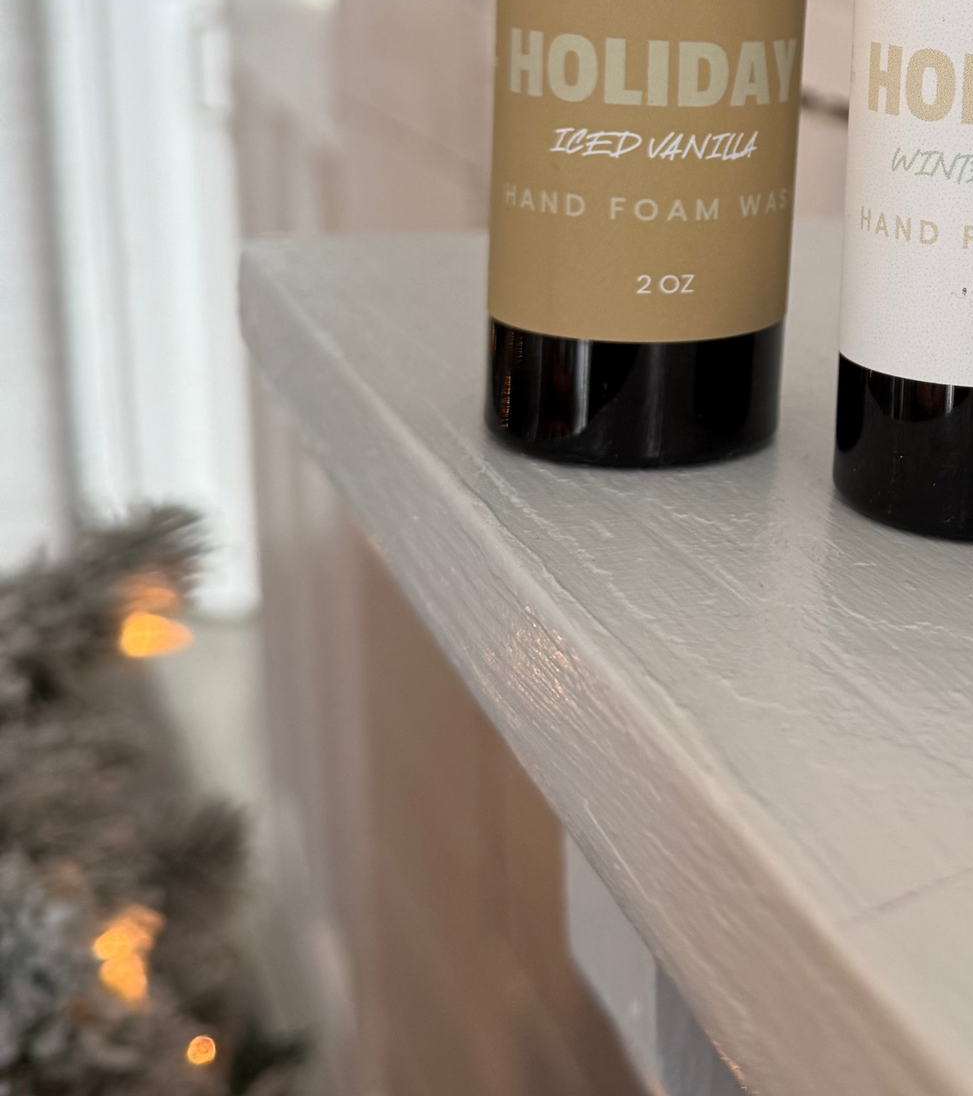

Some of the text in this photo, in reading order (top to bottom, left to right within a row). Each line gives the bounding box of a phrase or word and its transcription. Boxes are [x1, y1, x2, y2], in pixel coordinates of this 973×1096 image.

[509, 27, 797, 108] HOLIDAY
[549, 127, 758, 161] ICED VANILLA
[505, 183, 790, 222] HAND FOAM WAS
[860, 205, 939, 246] HAND
[636, 274, 695, 294] 2 OZ
